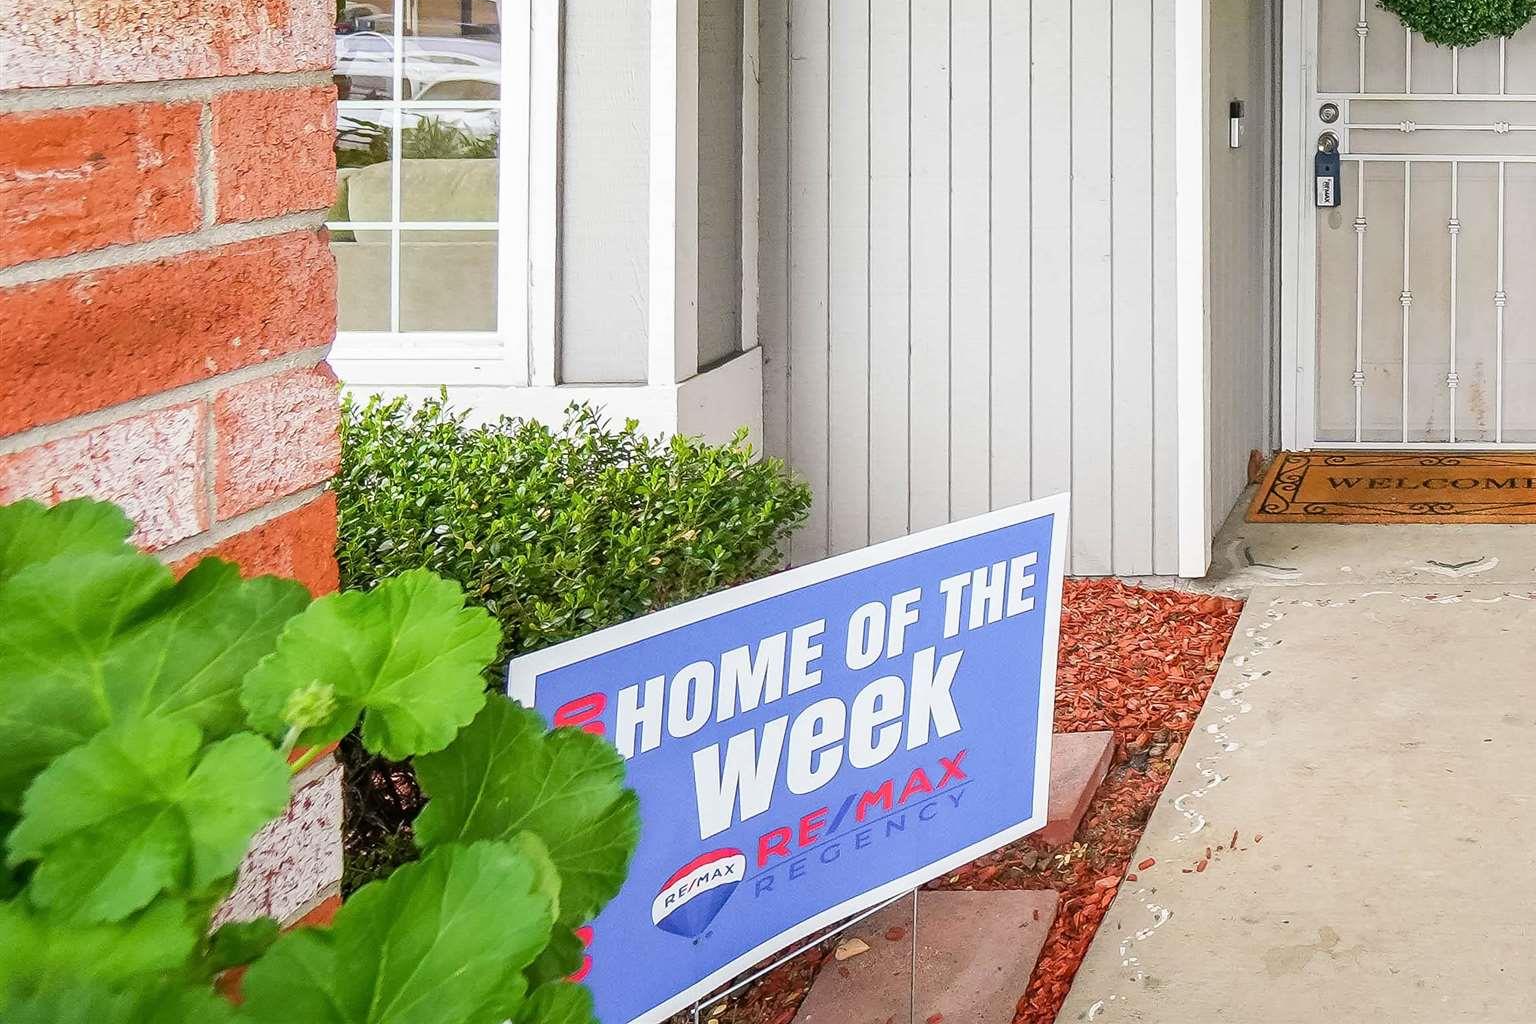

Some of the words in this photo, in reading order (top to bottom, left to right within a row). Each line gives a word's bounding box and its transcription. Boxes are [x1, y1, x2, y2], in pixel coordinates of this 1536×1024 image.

[615, 618, 826, 761] HOME
[844, 587, 923, 671] OF
[939, 551, 1038, 639] THE
[754, 788, 967, 899] REGENCY
[757, 748, 969, 869] RE/MAX
[663, 862, 735, 909] RE/MAX
